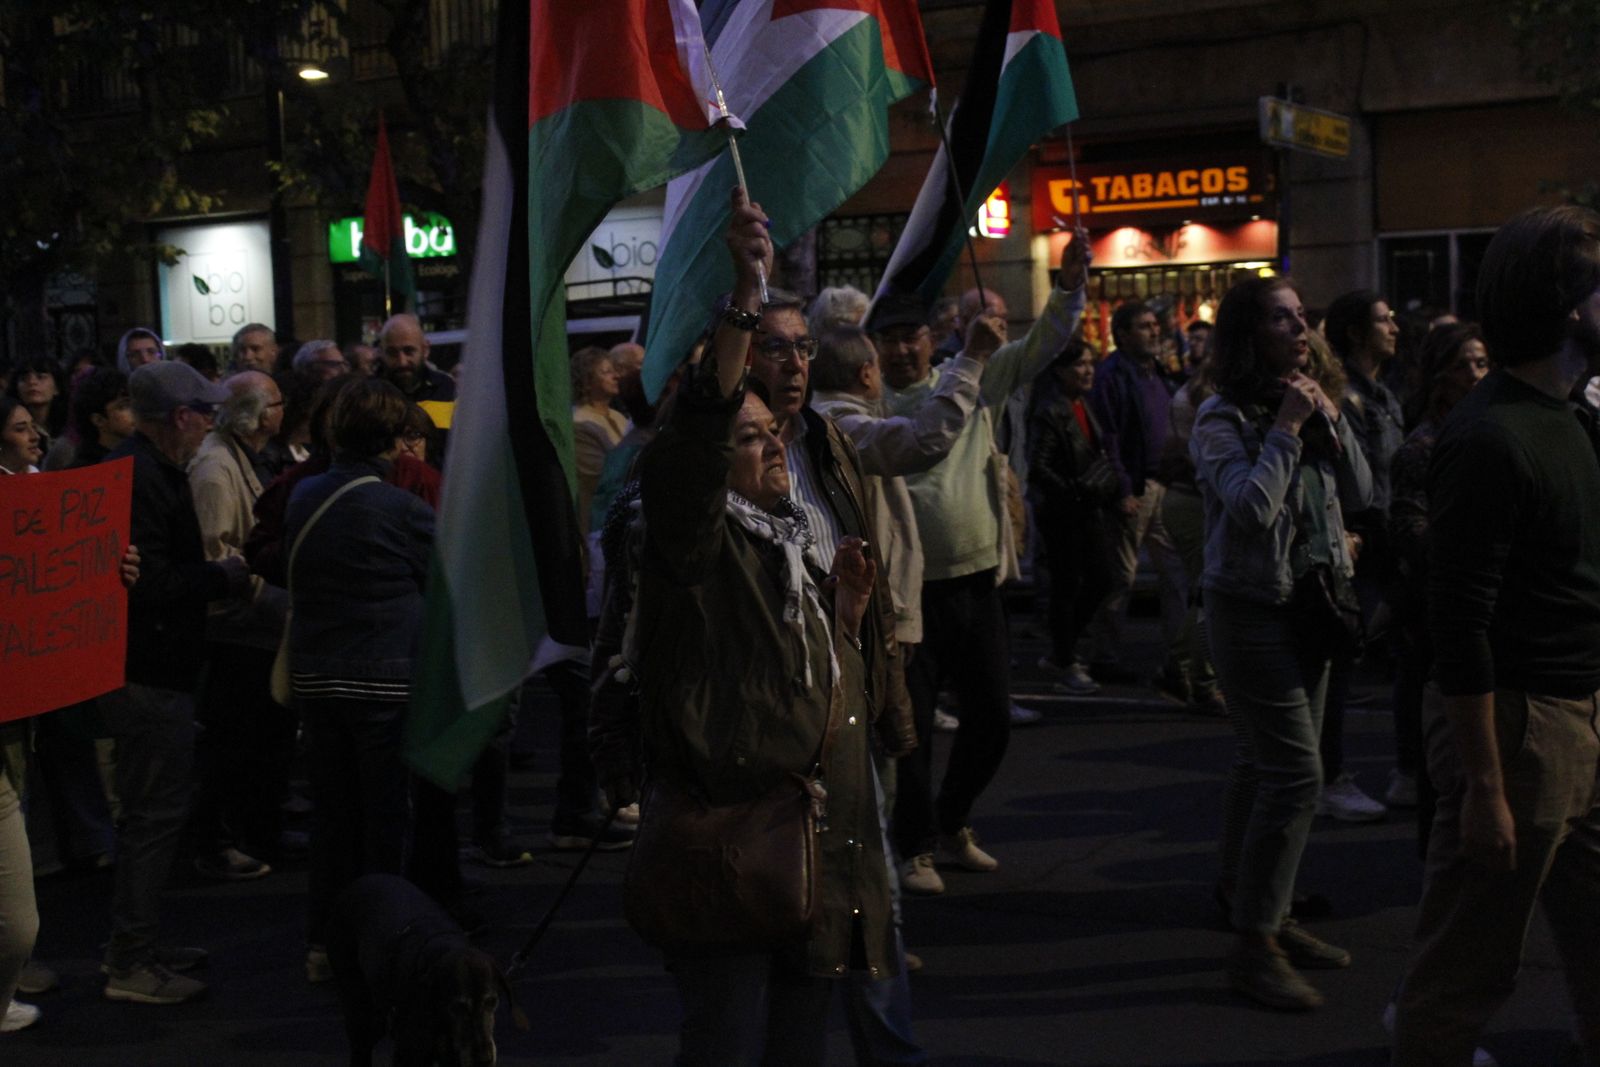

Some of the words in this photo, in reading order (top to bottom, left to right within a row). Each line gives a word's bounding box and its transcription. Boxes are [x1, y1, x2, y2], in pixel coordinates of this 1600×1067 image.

[1090, 165, 1250, 200] TABACOS
[610, 232, 658, 269] bio
[12, 508, 48, 537] DE
[60, 486, 108, 533] PAZ
[0, 593, 120, 661] ALESTINA
